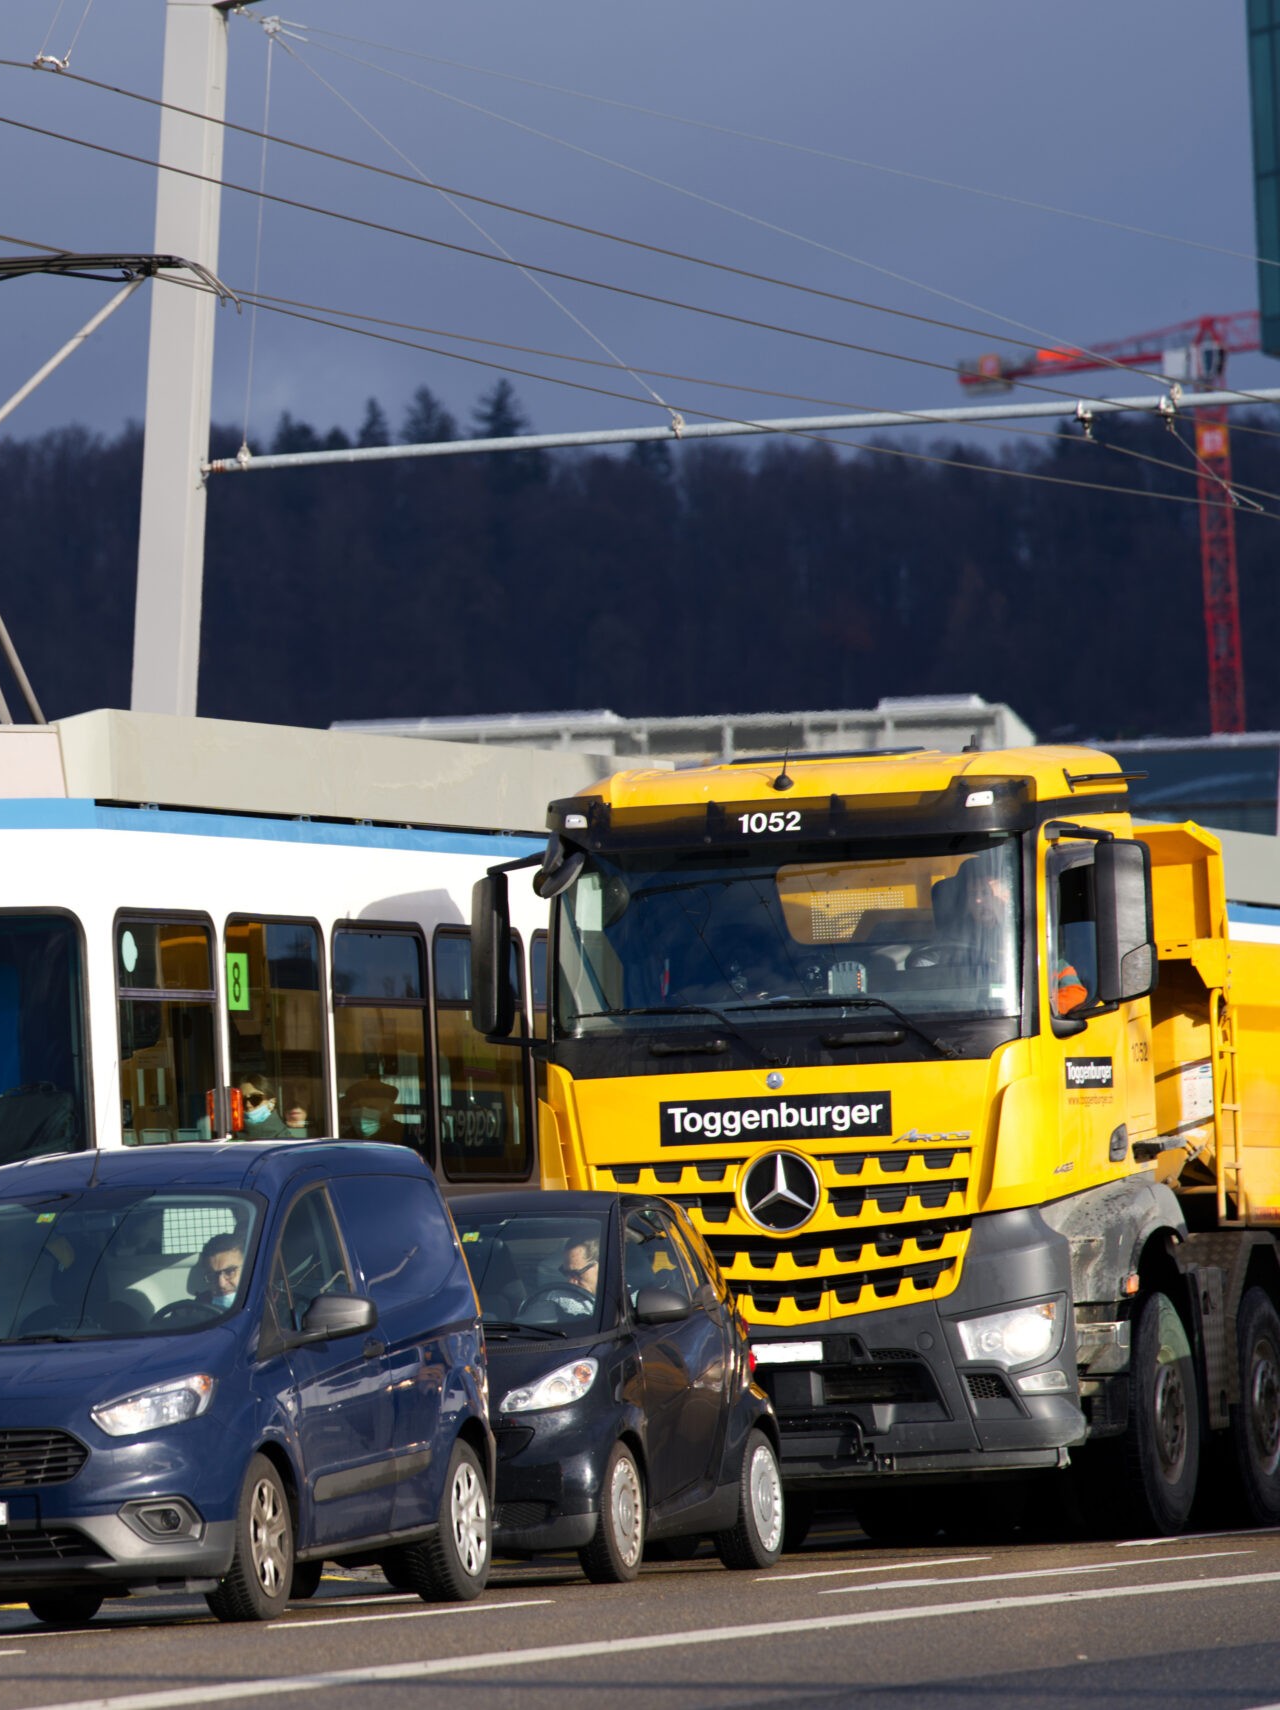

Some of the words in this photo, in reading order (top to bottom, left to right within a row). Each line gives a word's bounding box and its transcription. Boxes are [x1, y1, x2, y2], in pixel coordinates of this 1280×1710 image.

[738, 811, 801, 833] 1052
[232, 961, 241, 1003] 8
[1066, 1061, 1112, 1084] Toggenburger
[667, 1103, 883, 1138] Toggenburger
